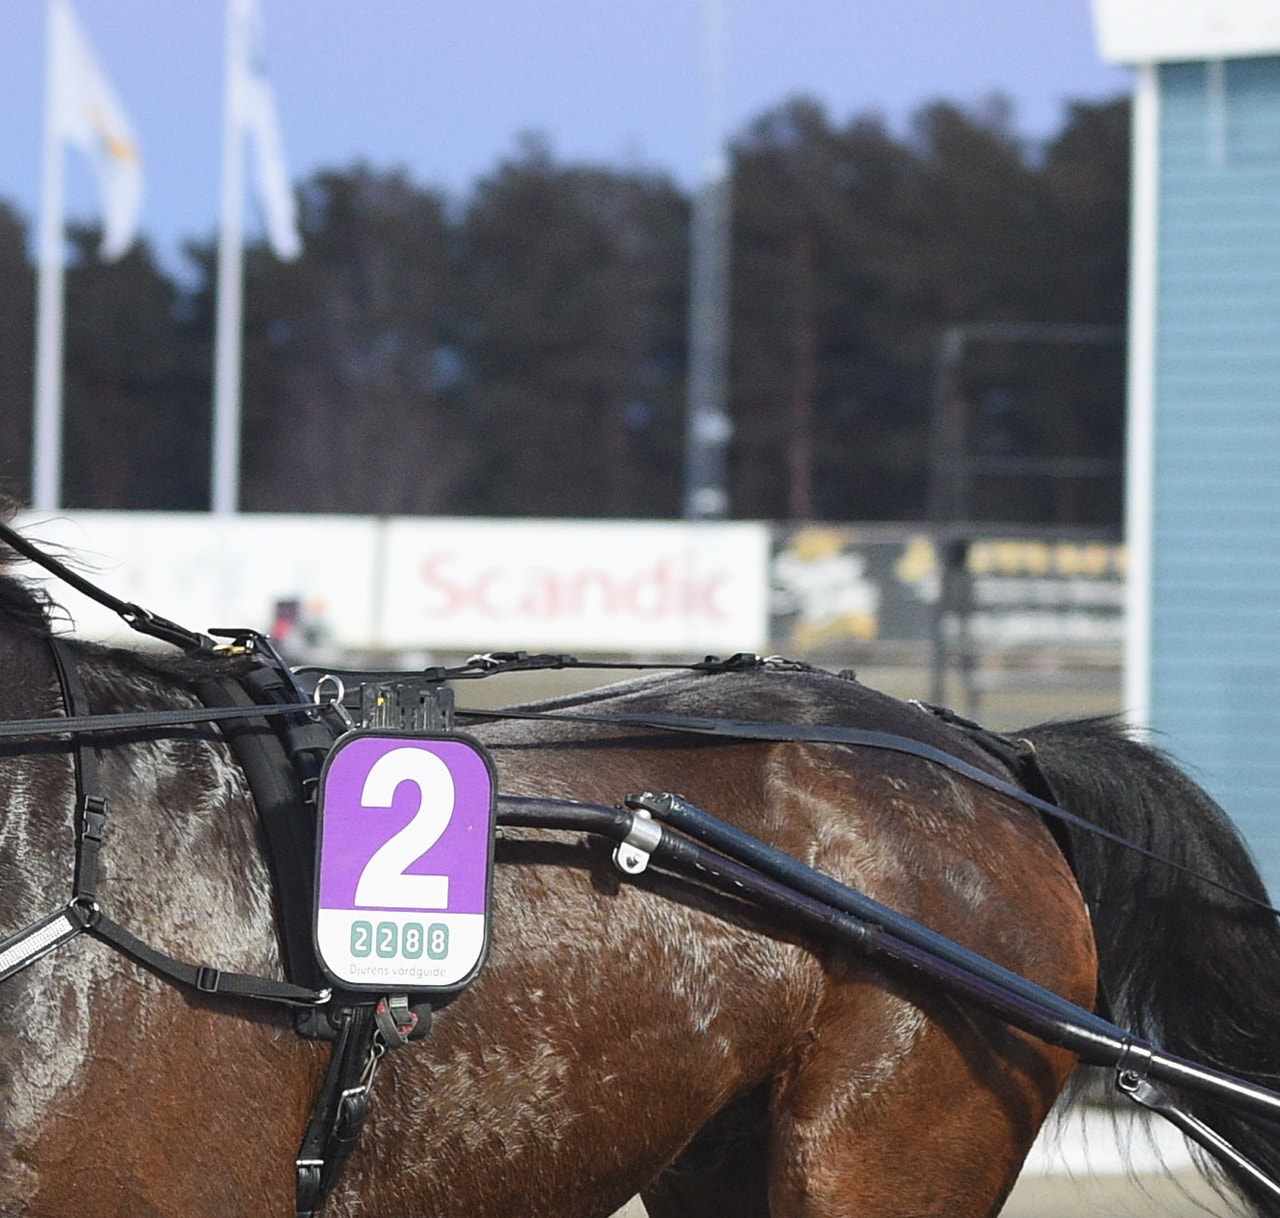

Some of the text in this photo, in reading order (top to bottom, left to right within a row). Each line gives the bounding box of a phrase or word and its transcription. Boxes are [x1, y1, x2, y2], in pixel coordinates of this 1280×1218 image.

[420, 548, 734, 621] Scandic
[354, 747, 455, 909] 2
[353, 925, 447, 956] 2288
[350, 964, 389, 977] Djurens
